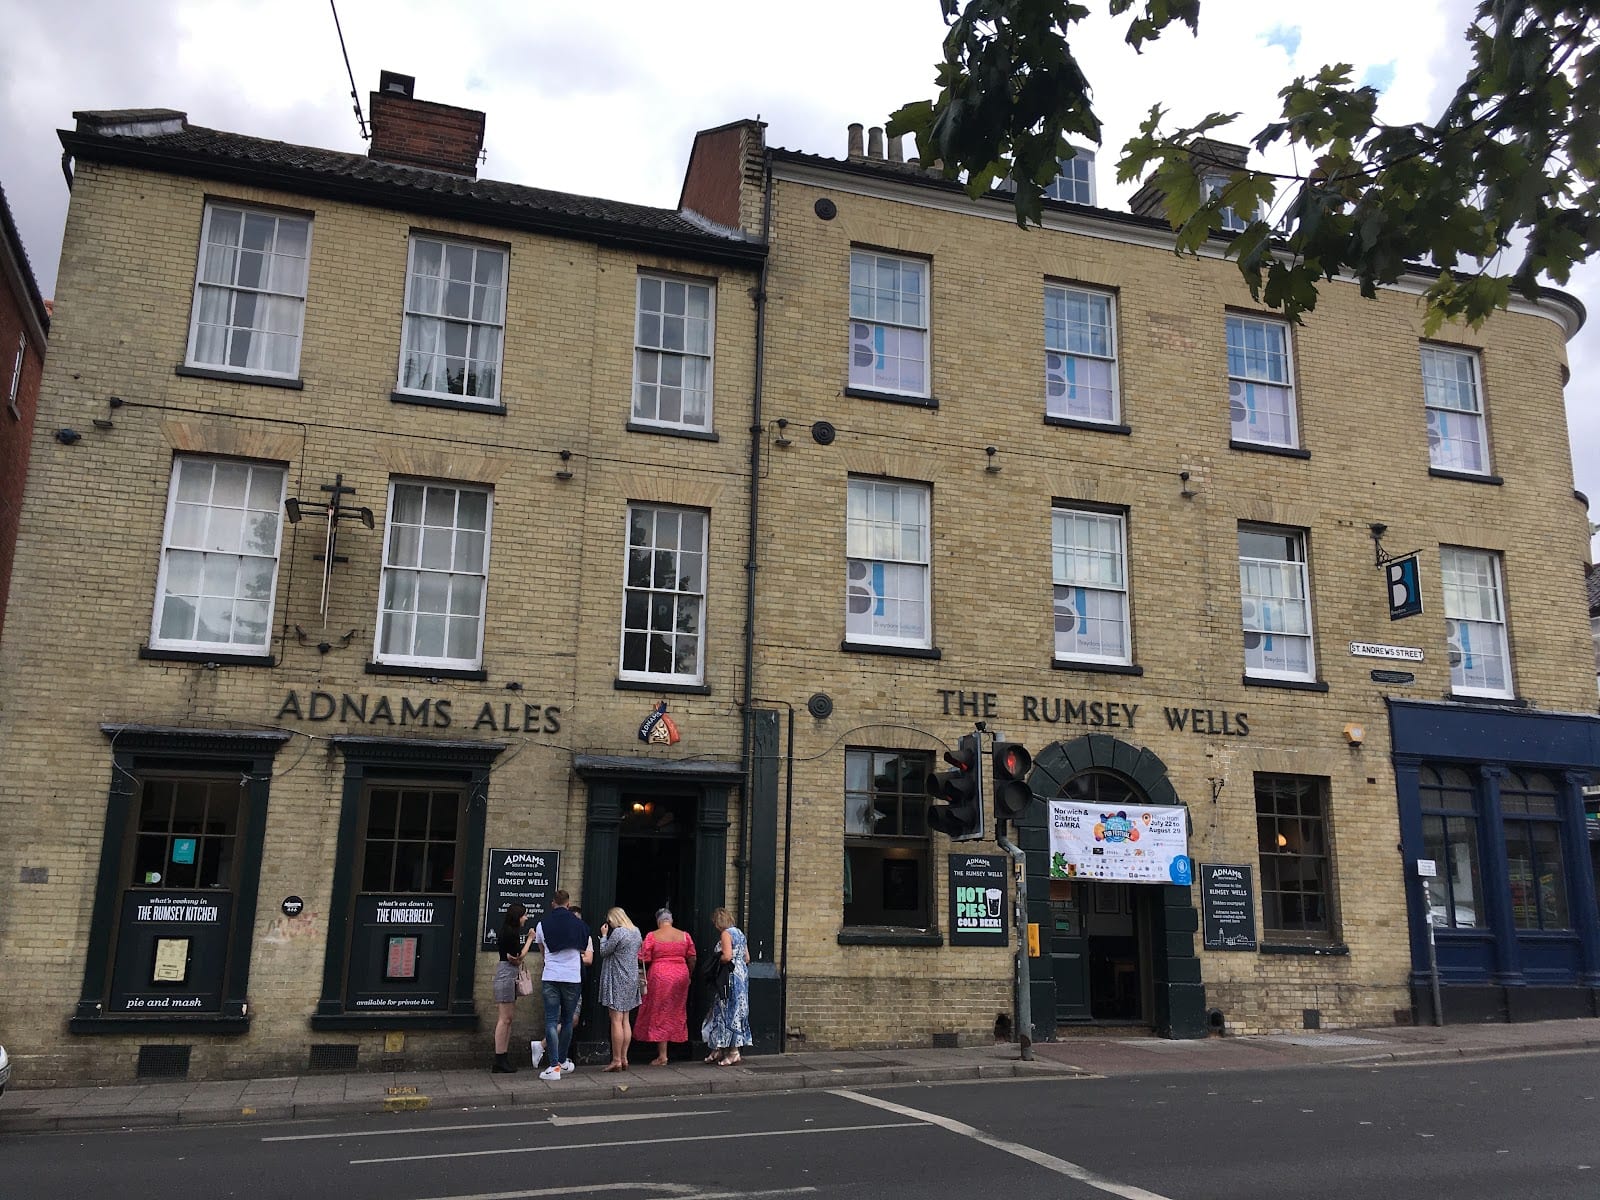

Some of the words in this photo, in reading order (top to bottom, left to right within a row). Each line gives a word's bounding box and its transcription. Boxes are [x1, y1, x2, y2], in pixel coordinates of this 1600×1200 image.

[1396, 649, 1423, 658] STREET
[276, 689, 452, 728] ADNAMS
[472, 701, 561, 734] ALES
[936, 689, 998, 718] THE
[1022, 695, 1139, 728] RUMSEY
[1163, 706, 1251, 736] WELLS
[641, 711, 662, 737] ADNAMS
[1054, 807, 1082, 815] Norwich
[1054, 821, 1081, 829] CAMRA
[504, 854, 545, 866] ADNAMS
[966, 858, 991, 867] ADNAMS
[1212, 868, 1243, 880] ADNAMS
[956, 886, 986, 903] HOT
[149, 897, 172, 905] what's
[172, 898, 199, 906] cooking
[199, 897, 208, 905] in
[137, 905, 153, 921] THE
[152, 905, 186, 921] RUMSEY
[185, 906, 218, 922] KITCHEN
[376, 908, 391, 923] THE
[390, 908, 435, 923] UNDERBELLY
[956, 903, 987, 918] PIES
[957, 918, 978, 928] COLD
[979, 918, 1002, 928] BEER!
[126, 997, 145, 1009] pie
[146, 997, 170, 1007] and
[171, 997, 202, 1007] mash
[387, 999, 397, 1007] for
[397, 999, 420, 1007] private
